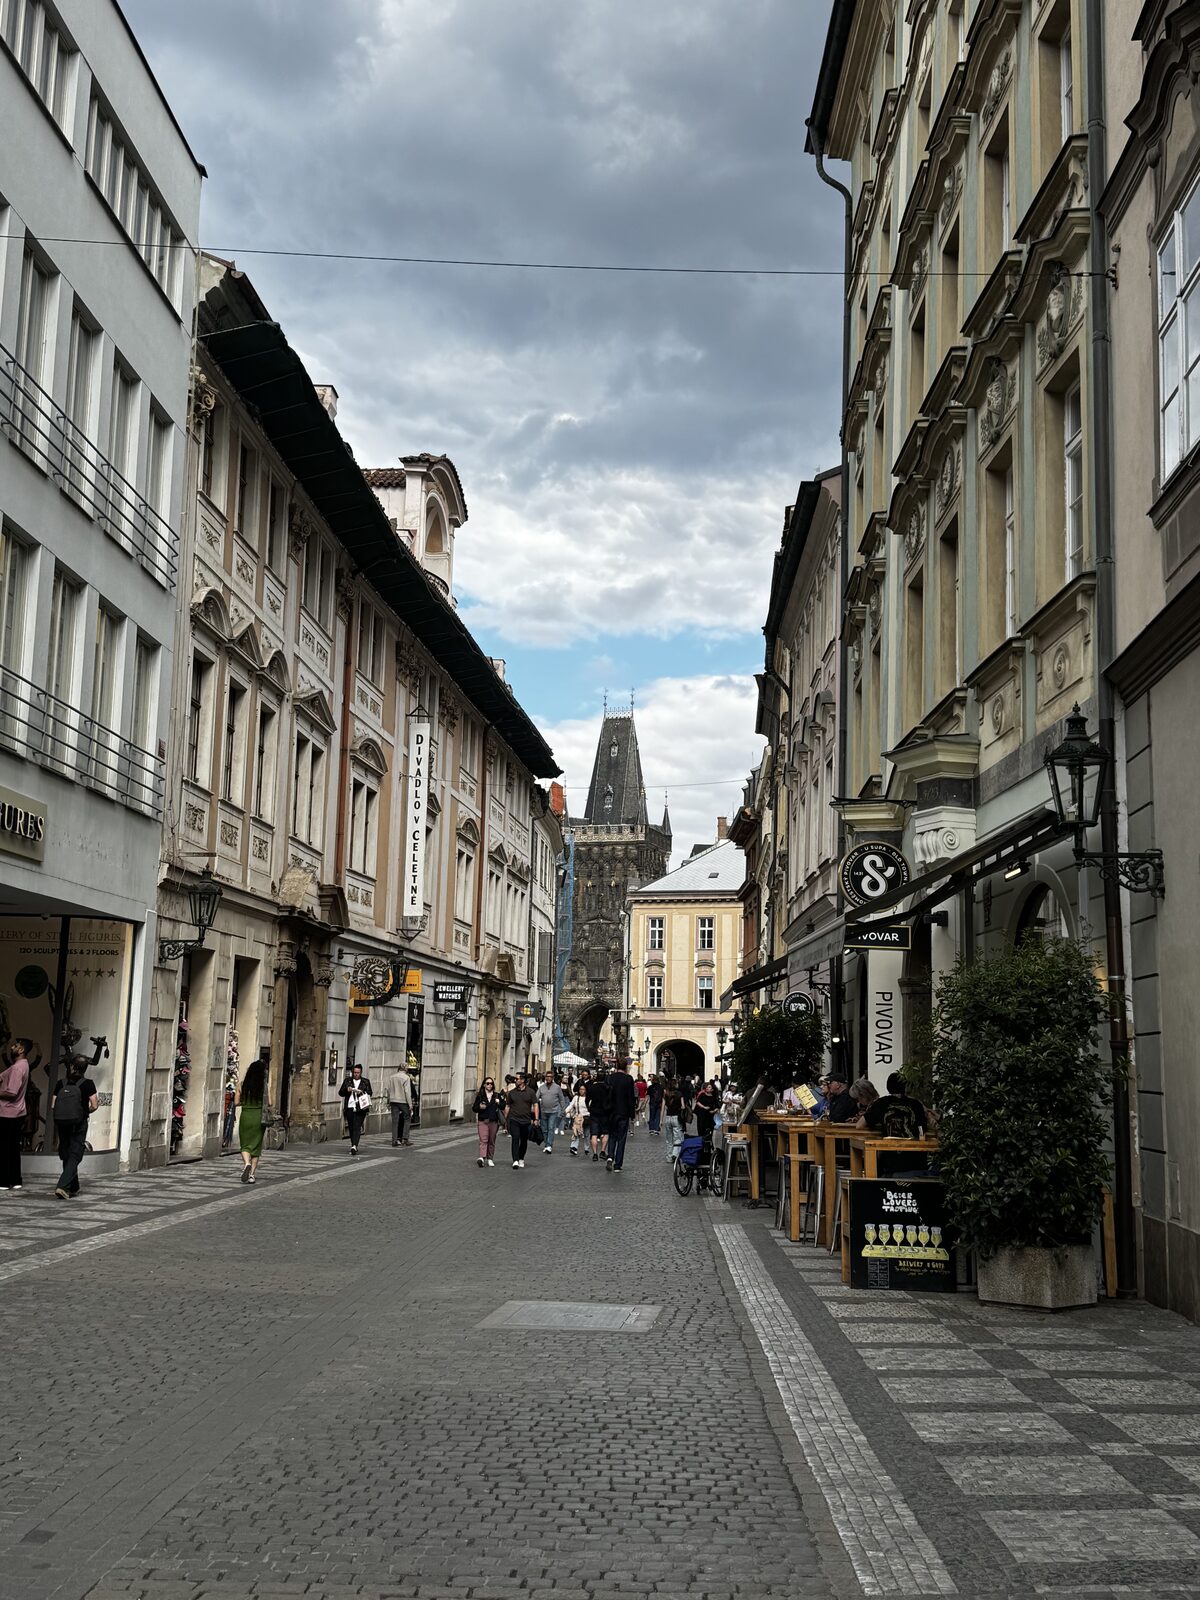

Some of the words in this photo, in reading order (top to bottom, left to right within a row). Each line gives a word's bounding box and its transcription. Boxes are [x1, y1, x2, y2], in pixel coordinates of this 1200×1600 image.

[414, 734, 424, 810] DIVADLO
[891, 851, 902, 862] OLD
[46, 931, 75, 941] STL
[438, 992, 461, 1000] WATCHES
[875, 991, 893, 1065] PIVOVAR
[882, 1198, 917, 1207] LOVERS
